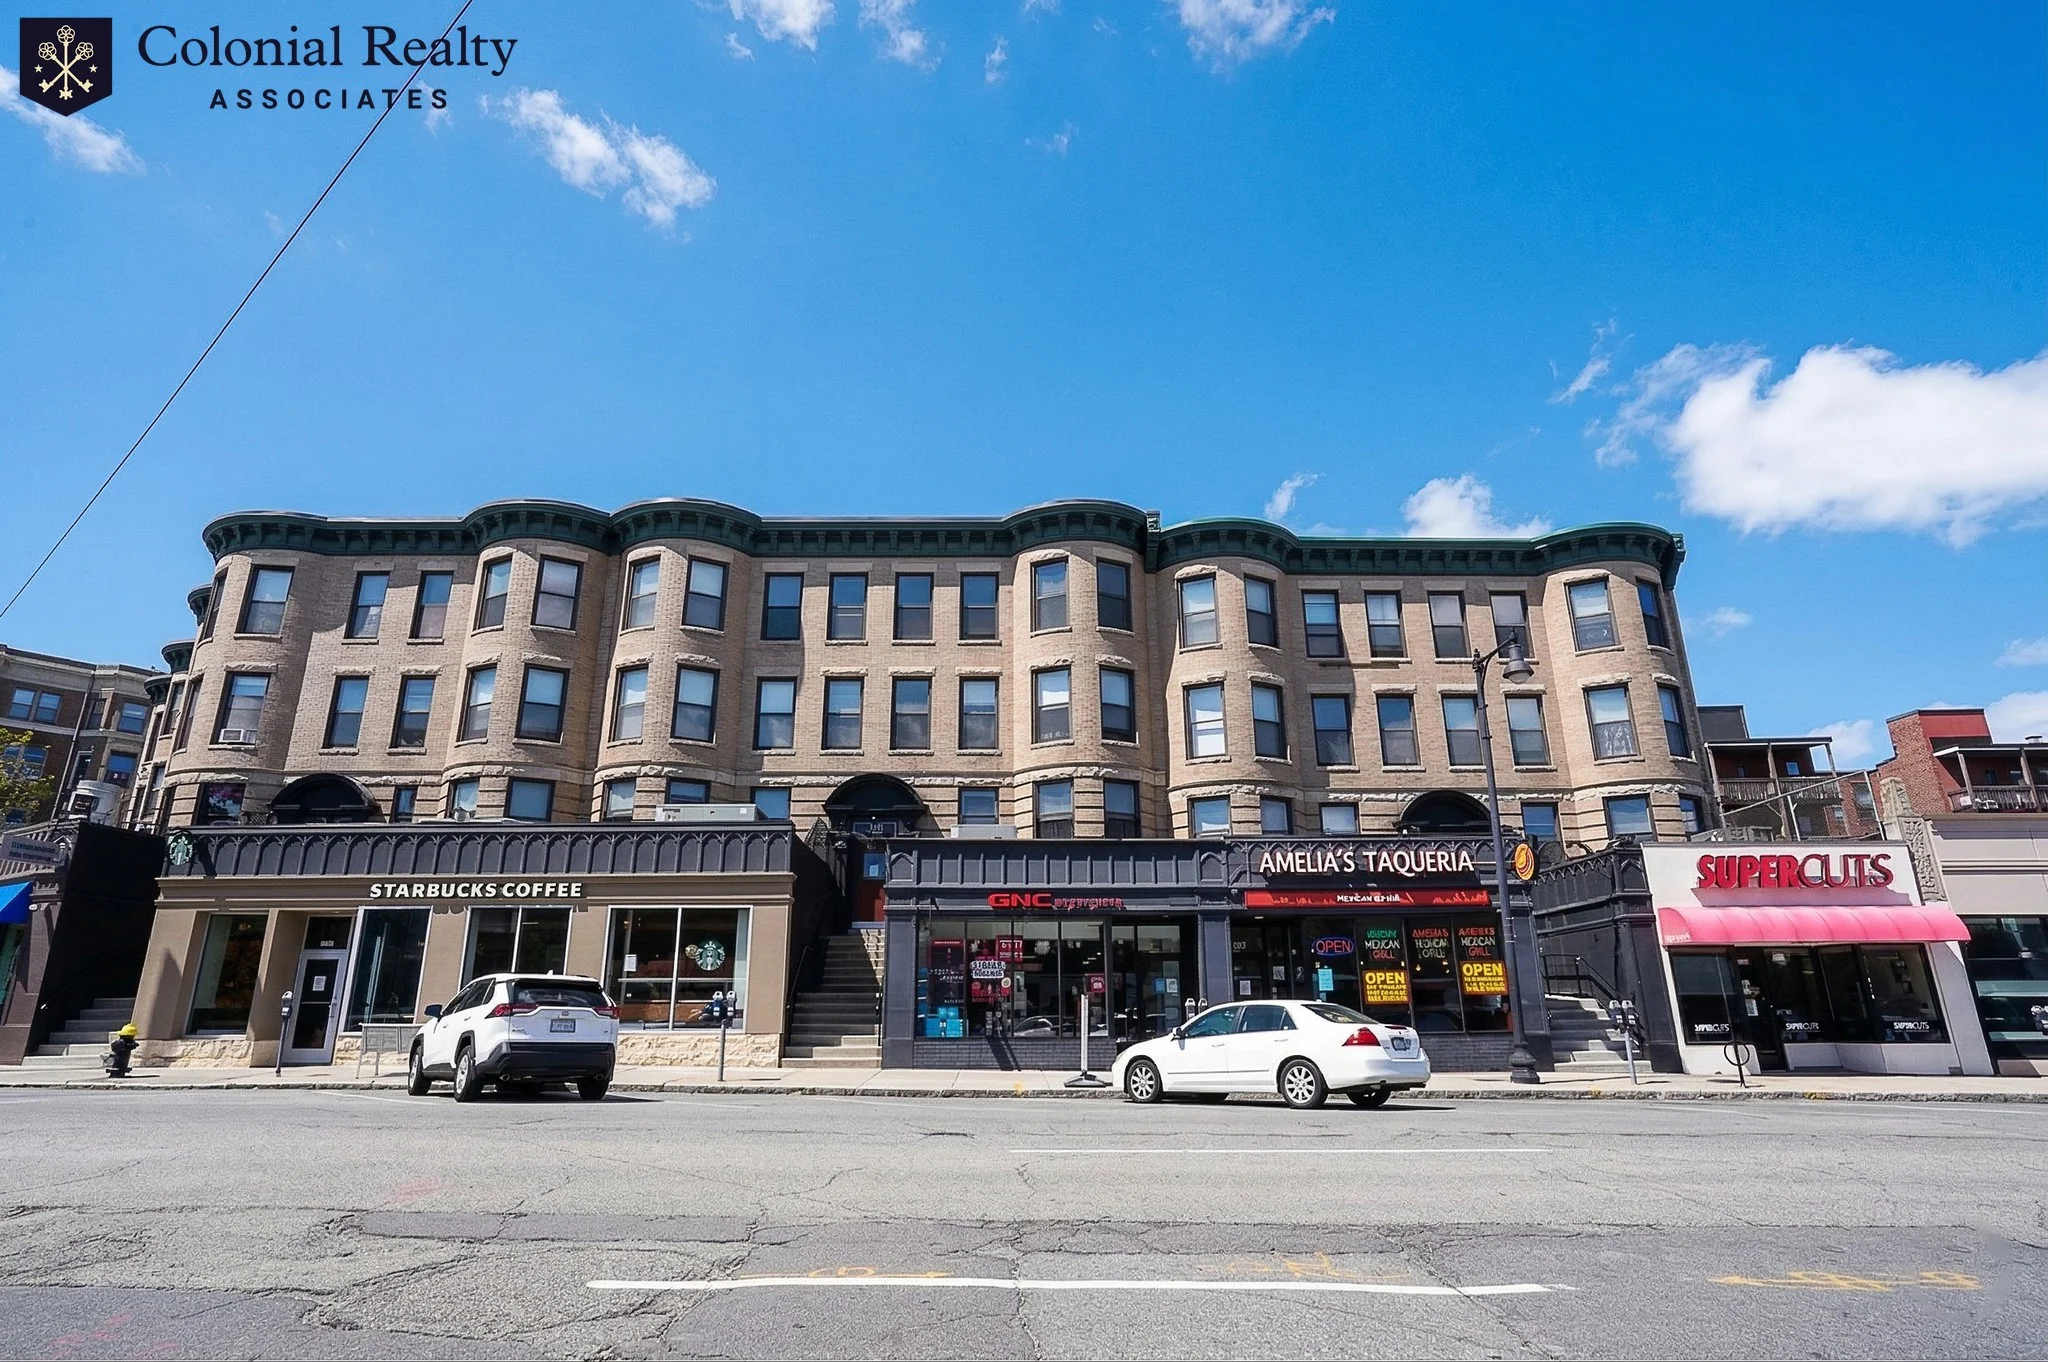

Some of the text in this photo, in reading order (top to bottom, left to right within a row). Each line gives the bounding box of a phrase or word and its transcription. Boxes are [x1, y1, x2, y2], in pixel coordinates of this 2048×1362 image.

[1259, 849, 1475, 877] AMELIA'S TAQUERIA
[1696, 852, 1894, 888] SUPERCUTS
[369, 882, 583, 898] STARBUCKS COFFEE
[987, 892, 1052, 908] GNC
[1315, 940, 1351, 953] OPEN
[1462, 963, 1503, 976] OPEN
[1365, 972, 1405, 985] OPEN
